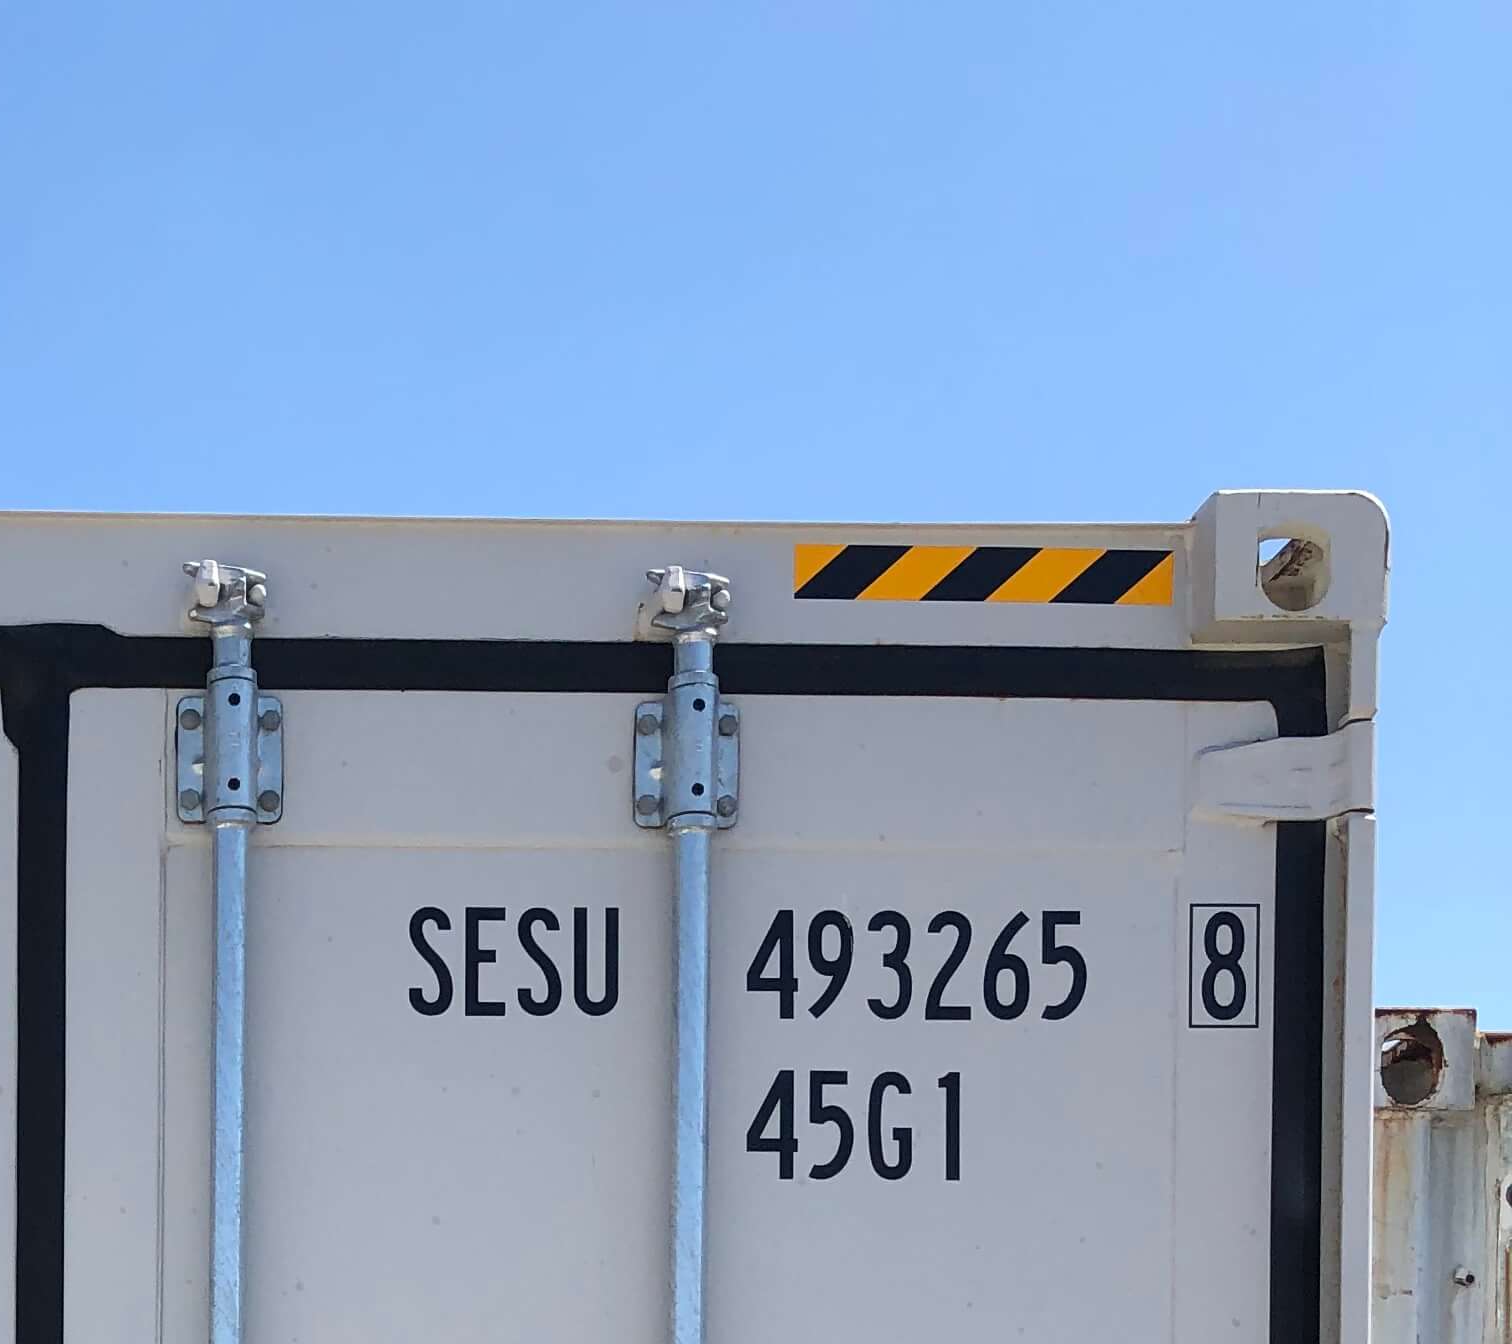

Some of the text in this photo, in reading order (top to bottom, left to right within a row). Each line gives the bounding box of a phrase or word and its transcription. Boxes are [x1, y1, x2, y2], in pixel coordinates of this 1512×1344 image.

[408, 906, 1246, 1022] SESU 493265 8
[744, 1069, 961, 1182] 45G1
